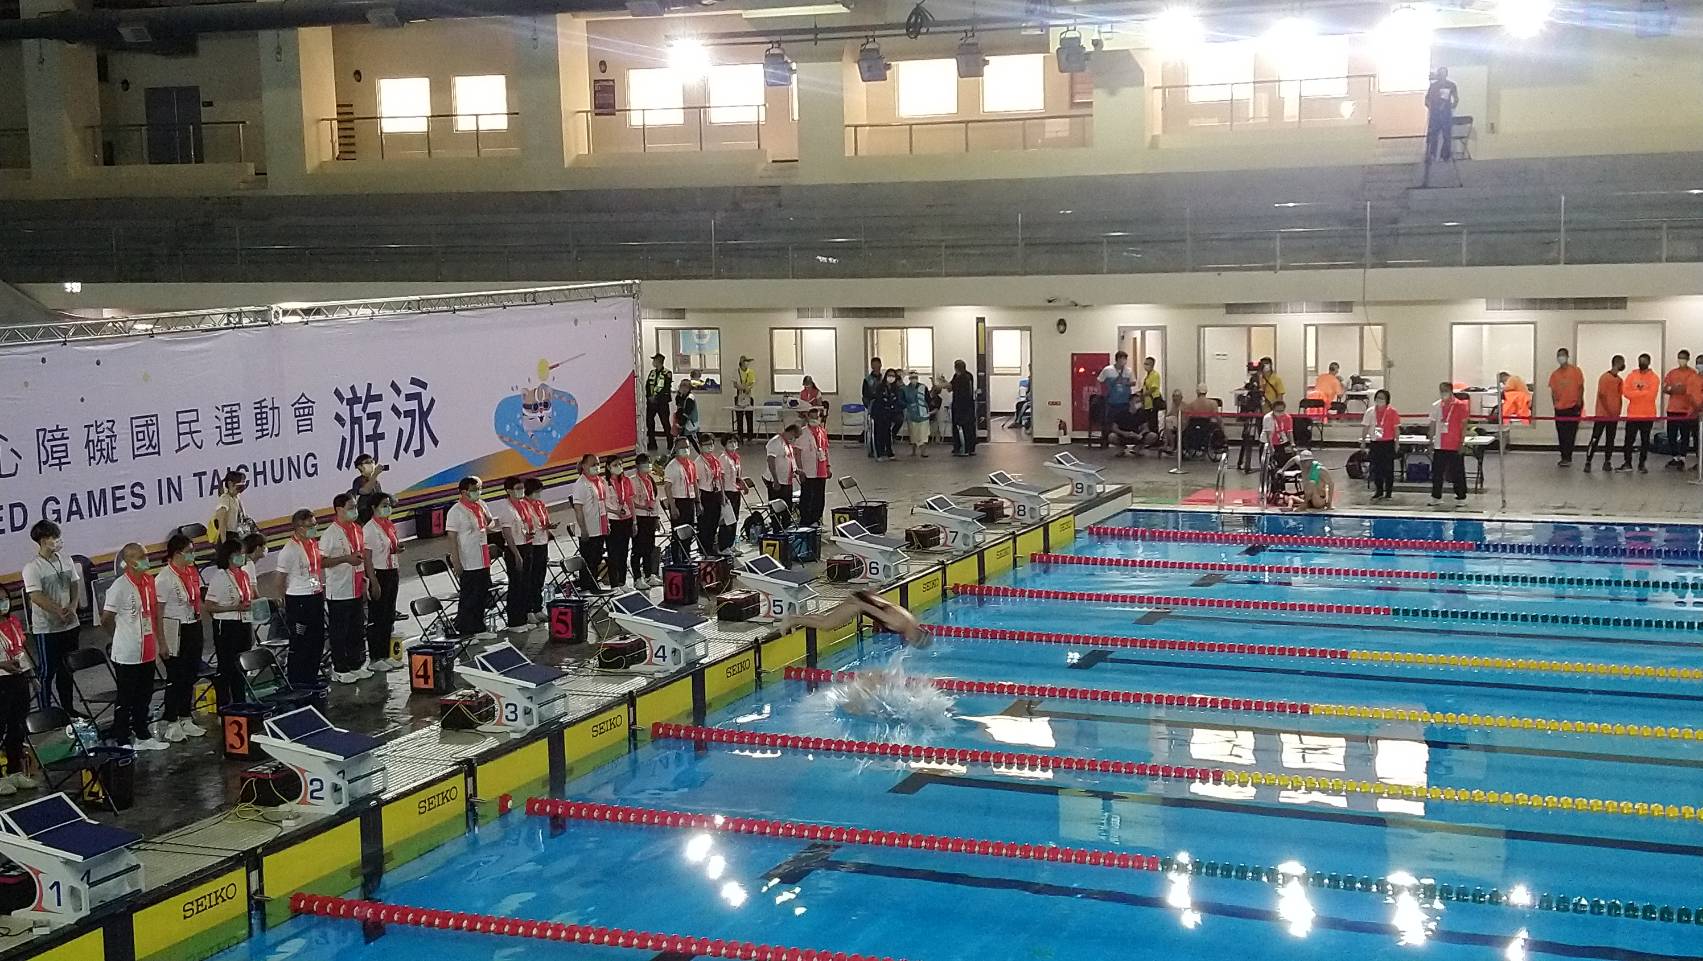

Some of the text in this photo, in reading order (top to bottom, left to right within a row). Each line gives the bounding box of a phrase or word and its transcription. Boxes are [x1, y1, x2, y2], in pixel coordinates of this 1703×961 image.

[333, 376, 440, 472] 游泳
[41, 481, 147, 526] GAMES
[157, 475, 183, 506] IN
[192, 452, 319, 498] TACHUNG
[1074, 482, 1084, 494] 9
[1016, 504, 1027, 517] 8
[949, 530, 959, 544] 7
[765, 543, 777, 560] 7
[868, 561, 880, 576] 6
[669, 574, 681, 598] 6
[772, 600, 784, 616] 5
[555, 611, 570, 635] 5
[653, 644, 668, 663] 4
[415, 658, 431, 686] 4
[725, 657, 751, 680] SEIKO
[504, 702, 519, 723] 3
[228, 719, 246, 750] 3
[591, 714, 624, 739] SEIKO
[309, 777, 325, 801] 2
[417, 786, 459, 816] SEIKO
[49, 880, 62, 907] 1
[182, 882, 238, 921] SEIKO
